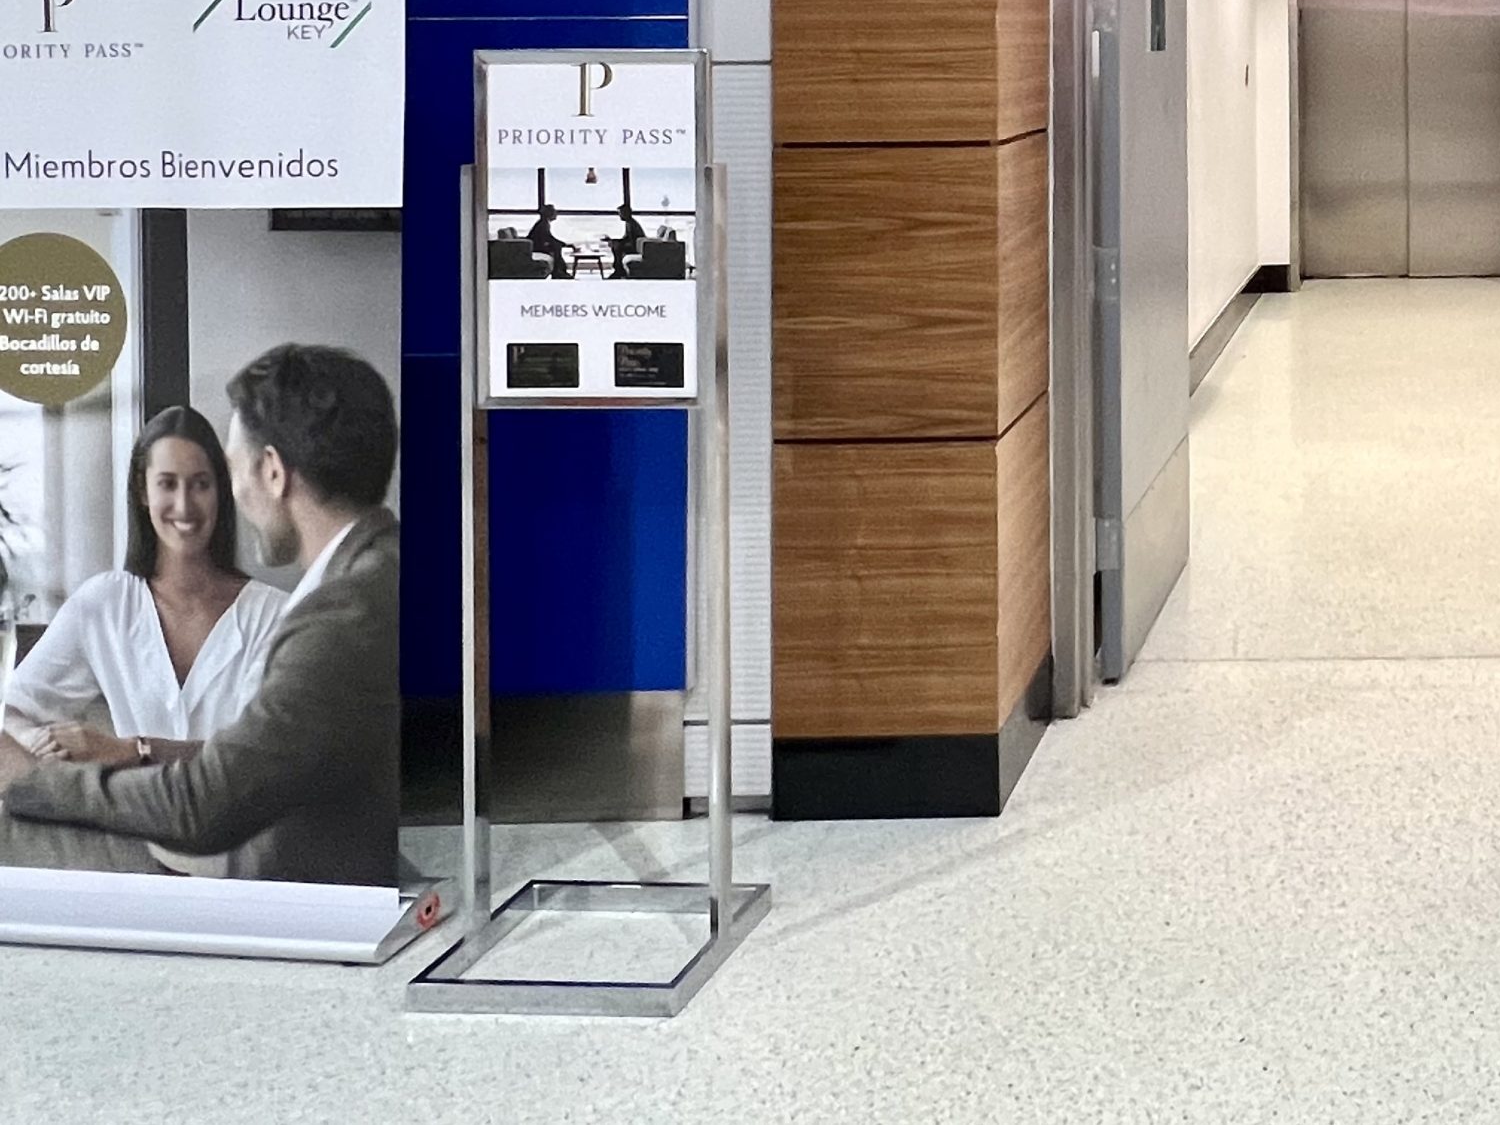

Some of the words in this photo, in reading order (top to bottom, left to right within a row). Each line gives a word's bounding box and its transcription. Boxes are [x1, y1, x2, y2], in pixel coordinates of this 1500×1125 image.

[287, 24, 326, 41] KEY
[498, 128, 608, 145] PRIORITY
[4, 149, 151, 180] Miembros
[161, 147, 339, 179] Bienvenidos
[41, 284, 80, 301] Salas
[83, 285, 111, 301] VIP
[51, 309, 111, 328] gratuito
[520, 304, 588, 318] MEMBERS
[592, 304, 667, 318] WELCOME
[0, 333, 77, 351] Bocadillos
[80, 334, 100, 351] de
[20, 360, 80, 376] cortesía
